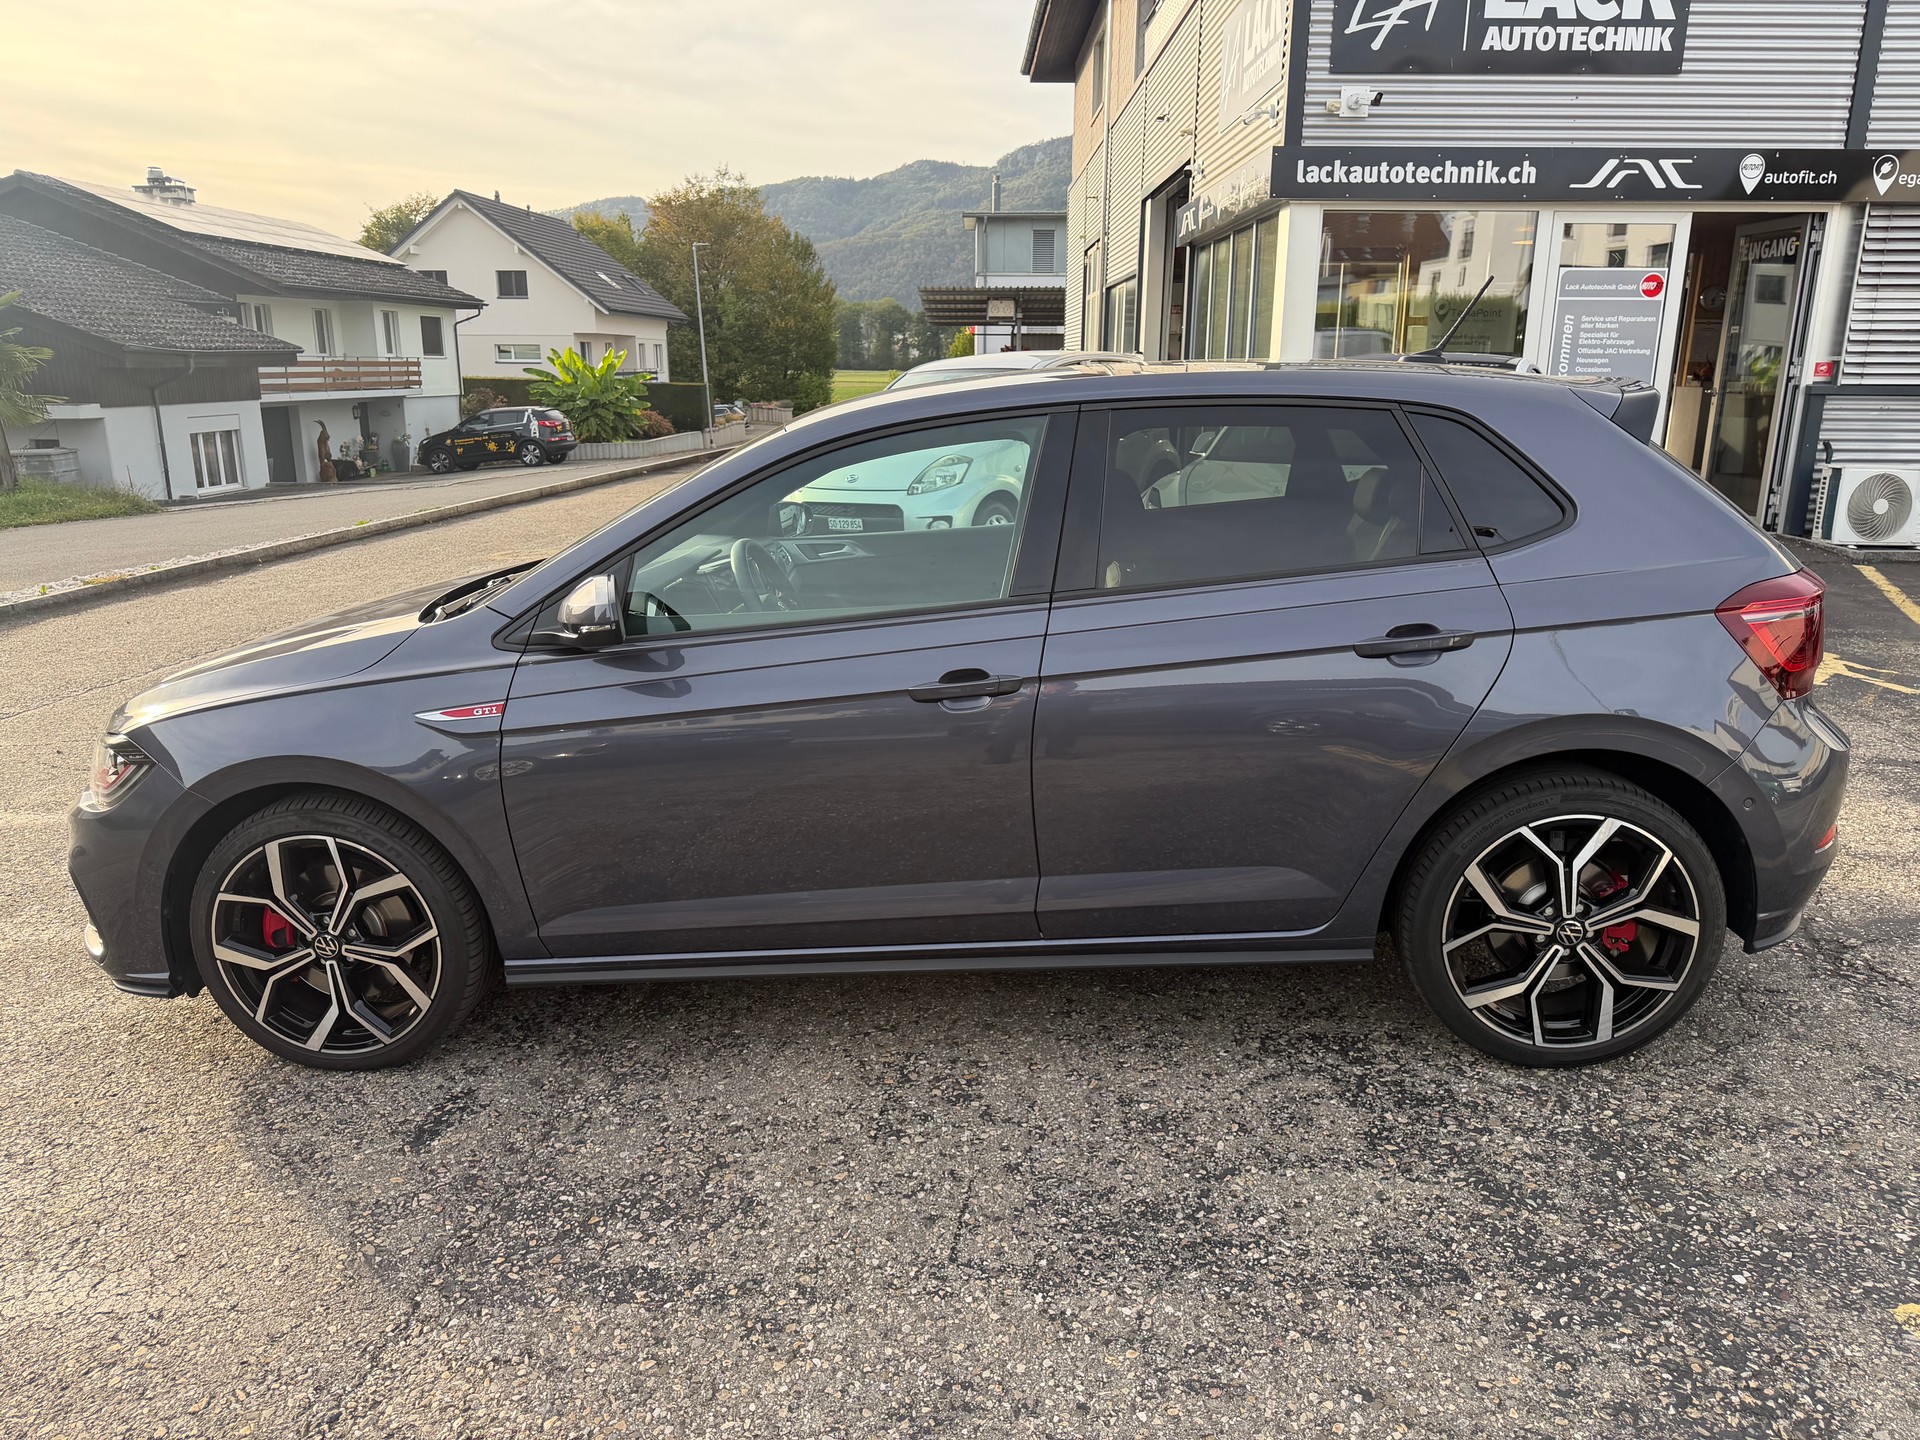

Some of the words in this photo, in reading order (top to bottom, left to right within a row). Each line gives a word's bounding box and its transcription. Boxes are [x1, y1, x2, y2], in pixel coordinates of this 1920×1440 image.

[1481, 26, 1675, 51] AUTOTECHNIK
[1297, 160, 1536, 184] lackautotechnik.ch
[1764, 170, 1837, 184] autofit.ch
[1740, 237, 1797, 261] EINGANG
[1618, 315, 1656, 323] Reparaturen
[838, 519, 849, 528] 129
[850, 520, 862, 529] 854
[473, 706, 497, 716] GTI
